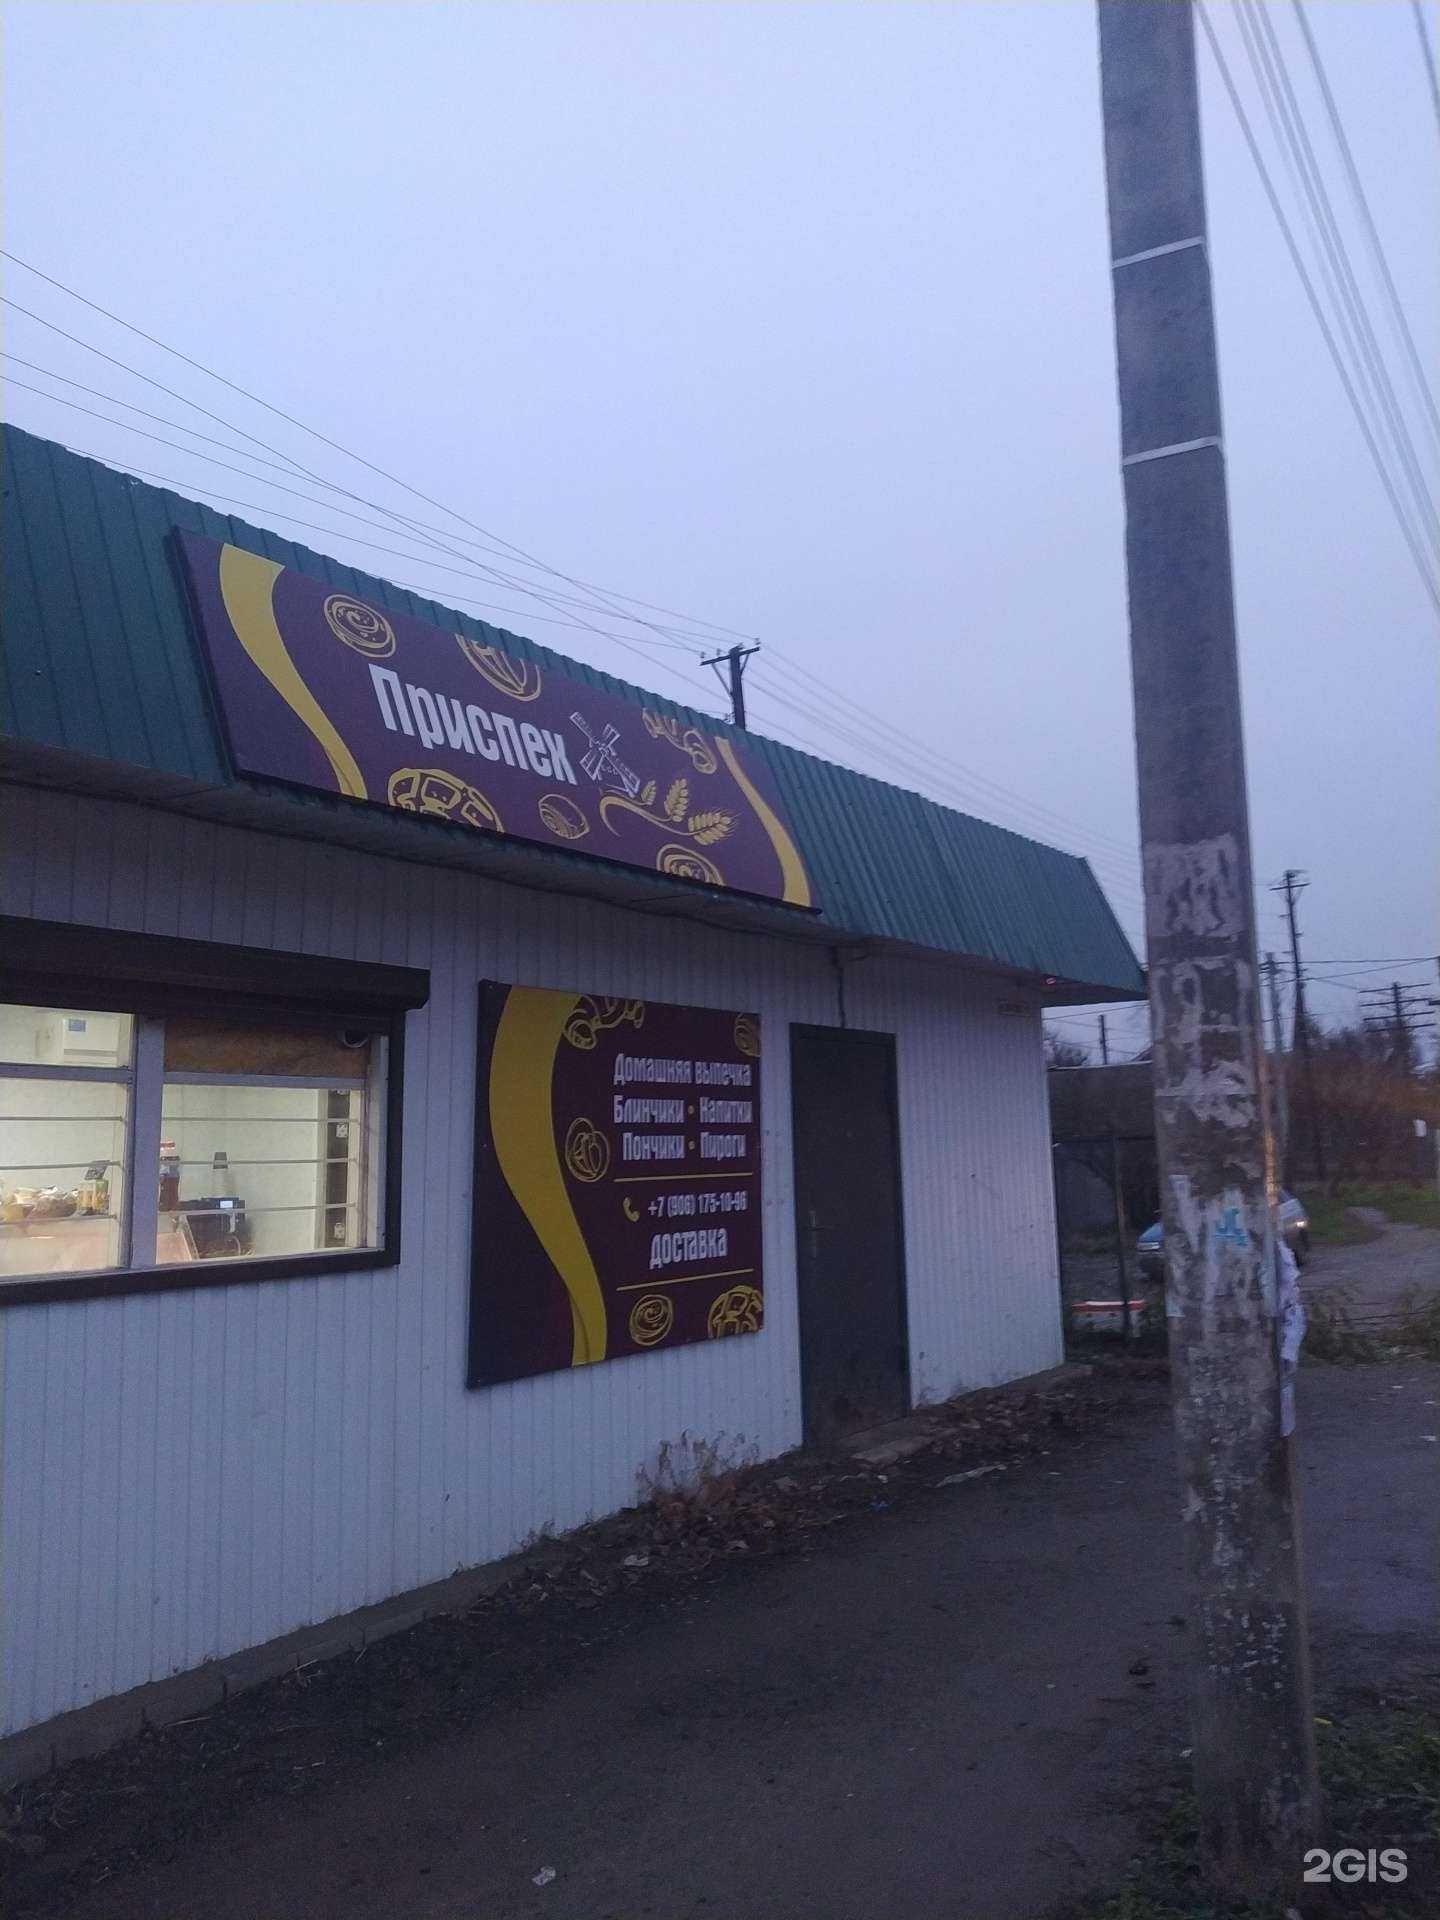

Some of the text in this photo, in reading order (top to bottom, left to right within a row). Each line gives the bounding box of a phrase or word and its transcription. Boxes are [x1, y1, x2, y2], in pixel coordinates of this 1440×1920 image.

[368, 663, 577, 786] Приспек
[613, 1053, 753, 1087] Домашняя выпечка
[613, 1094, 753, 1123] Блинчики Напитки
[622, 1131, 746, 1161] Пончики Пироги
[648, 1196, 666, 1218] +7
